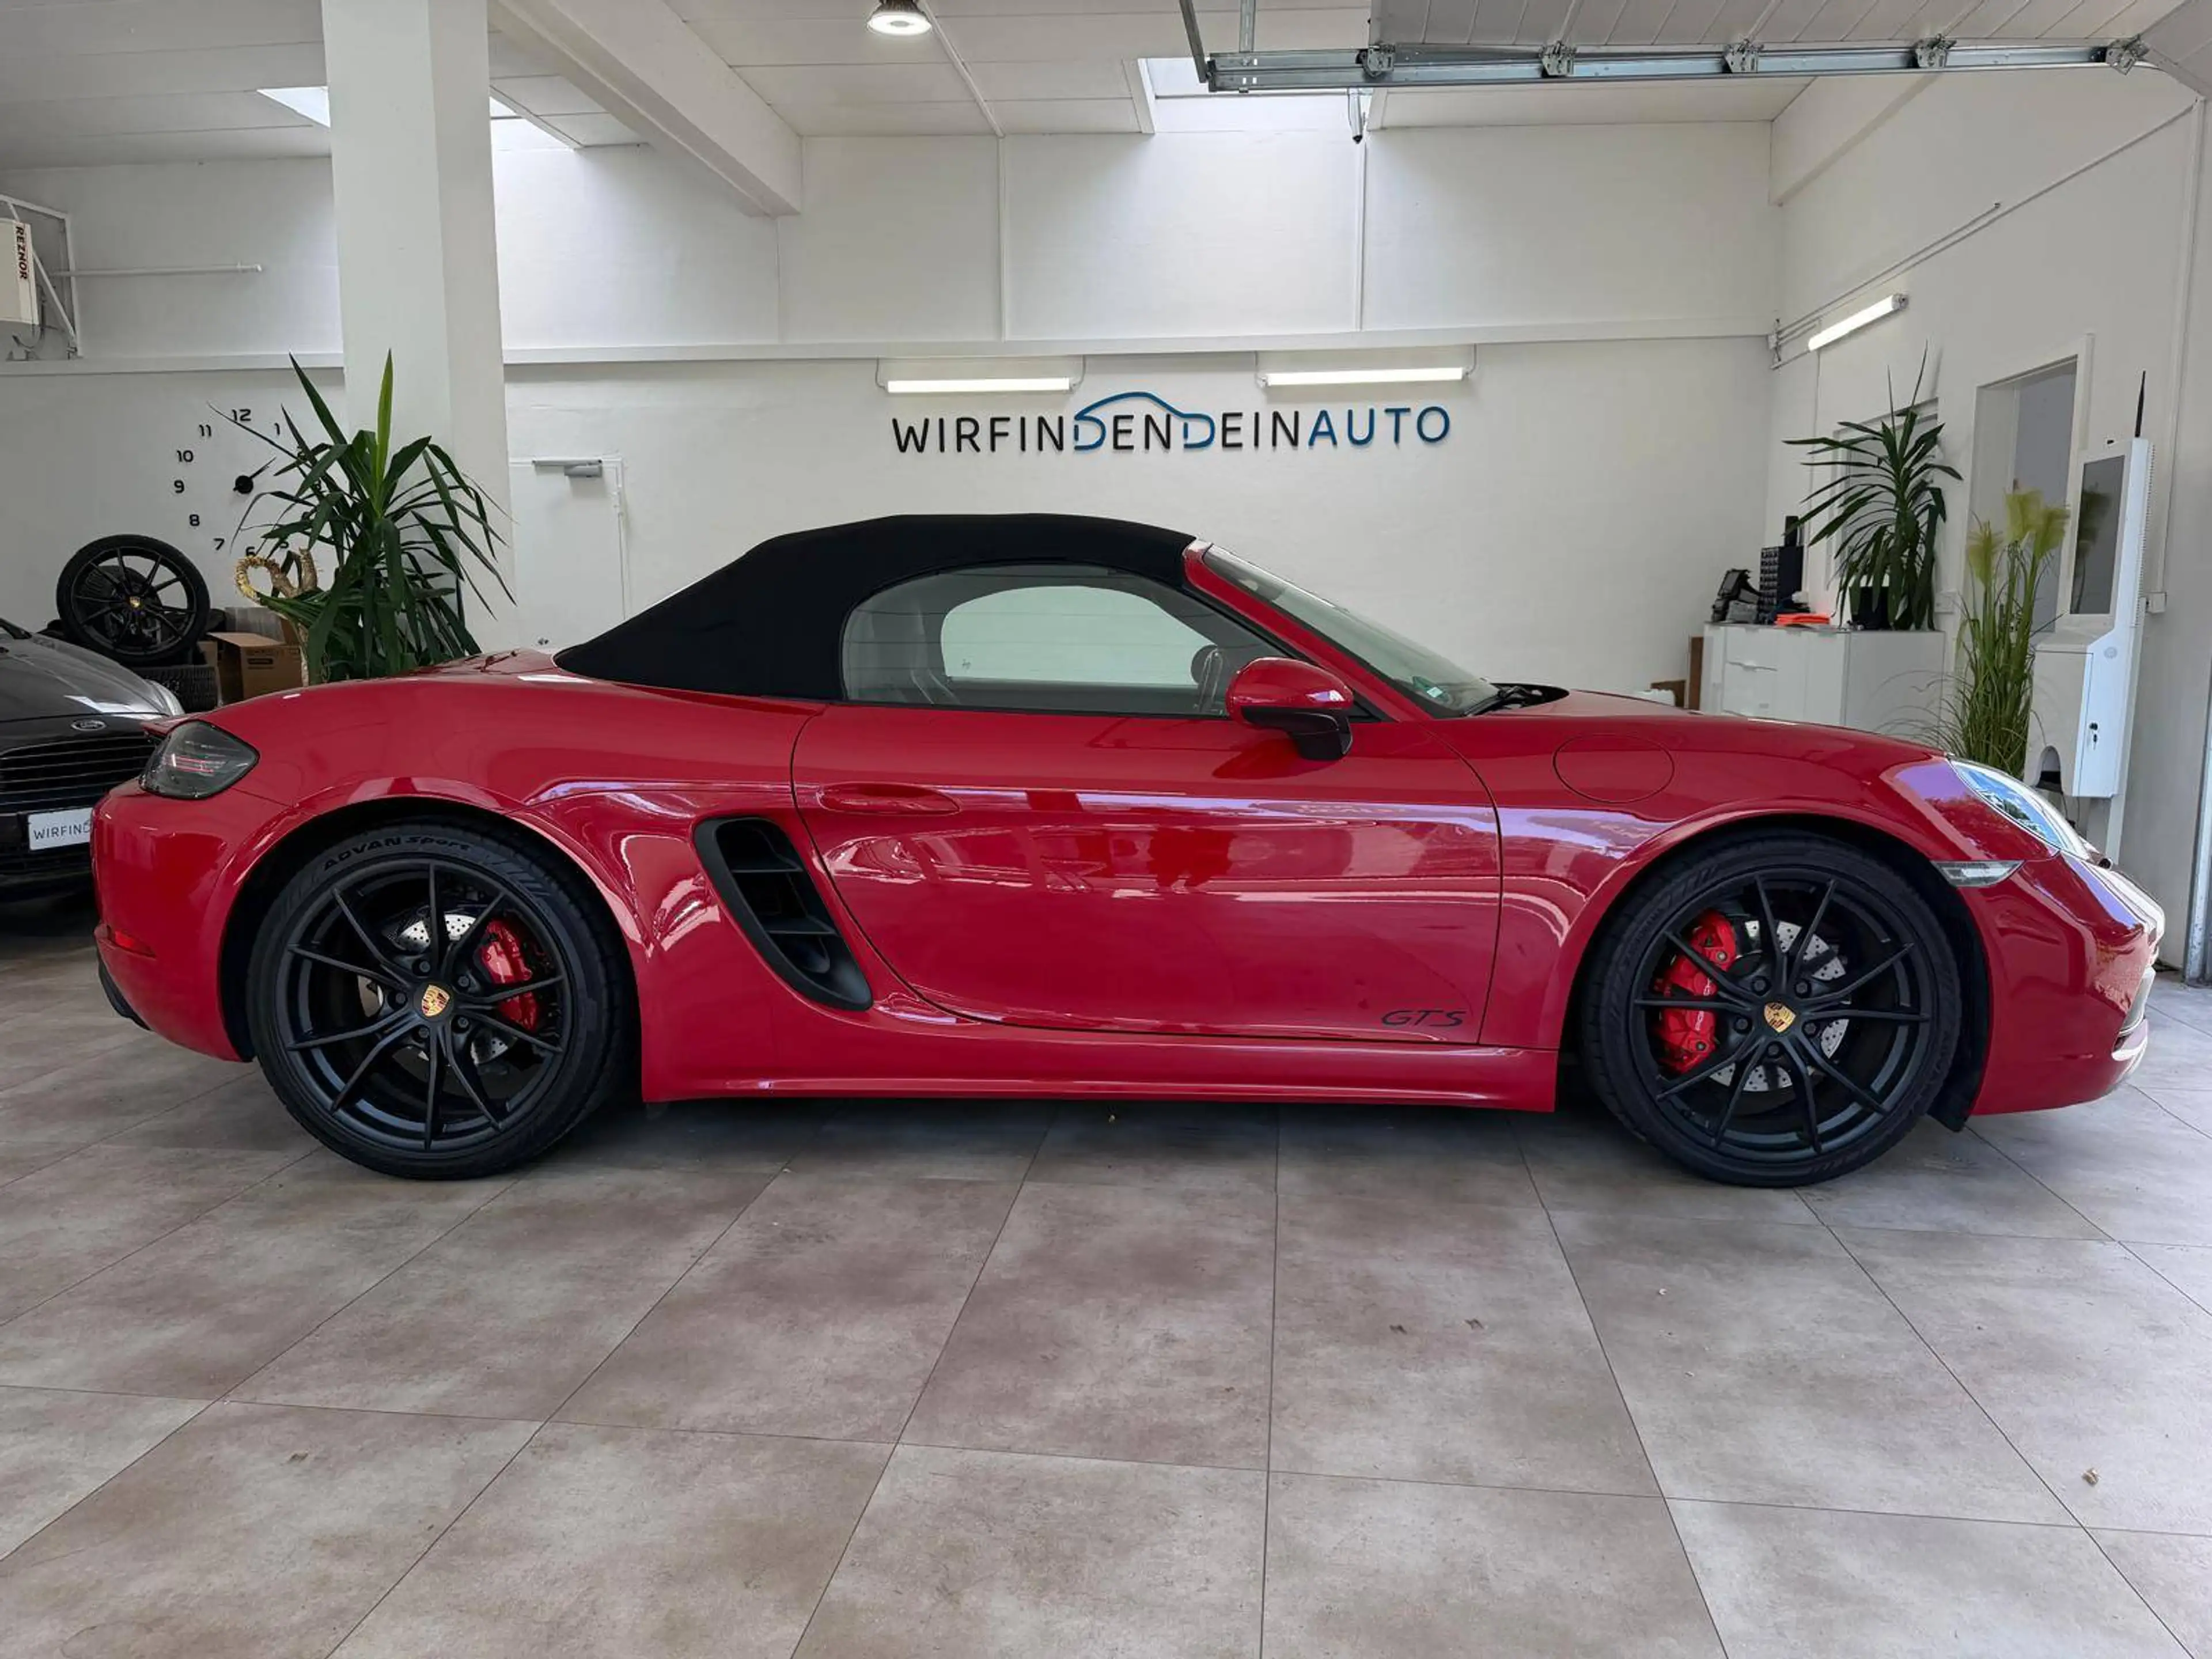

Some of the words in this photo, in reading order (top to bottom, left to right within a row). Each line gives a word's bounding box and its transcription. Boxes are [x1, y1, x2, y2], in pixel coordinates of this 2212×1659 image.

[16, 226, 28, 280] REZNOR
[232, 408, 251, 422] 12
[199, 424, 211, 437] 11
[274, 423, 280, 435] 1
[891, 403, 1450, 454] WIRFINDENDEINAUTO
[177, 450, 194, 463] 10
[175, 480, 185, 494] 9
[189, 514, 200, 527] 8
[214, 538, 225, 551] 7
[324, 836, 401, 872] ADVAN
[1381, 1009, 1467, 1028] GTS
